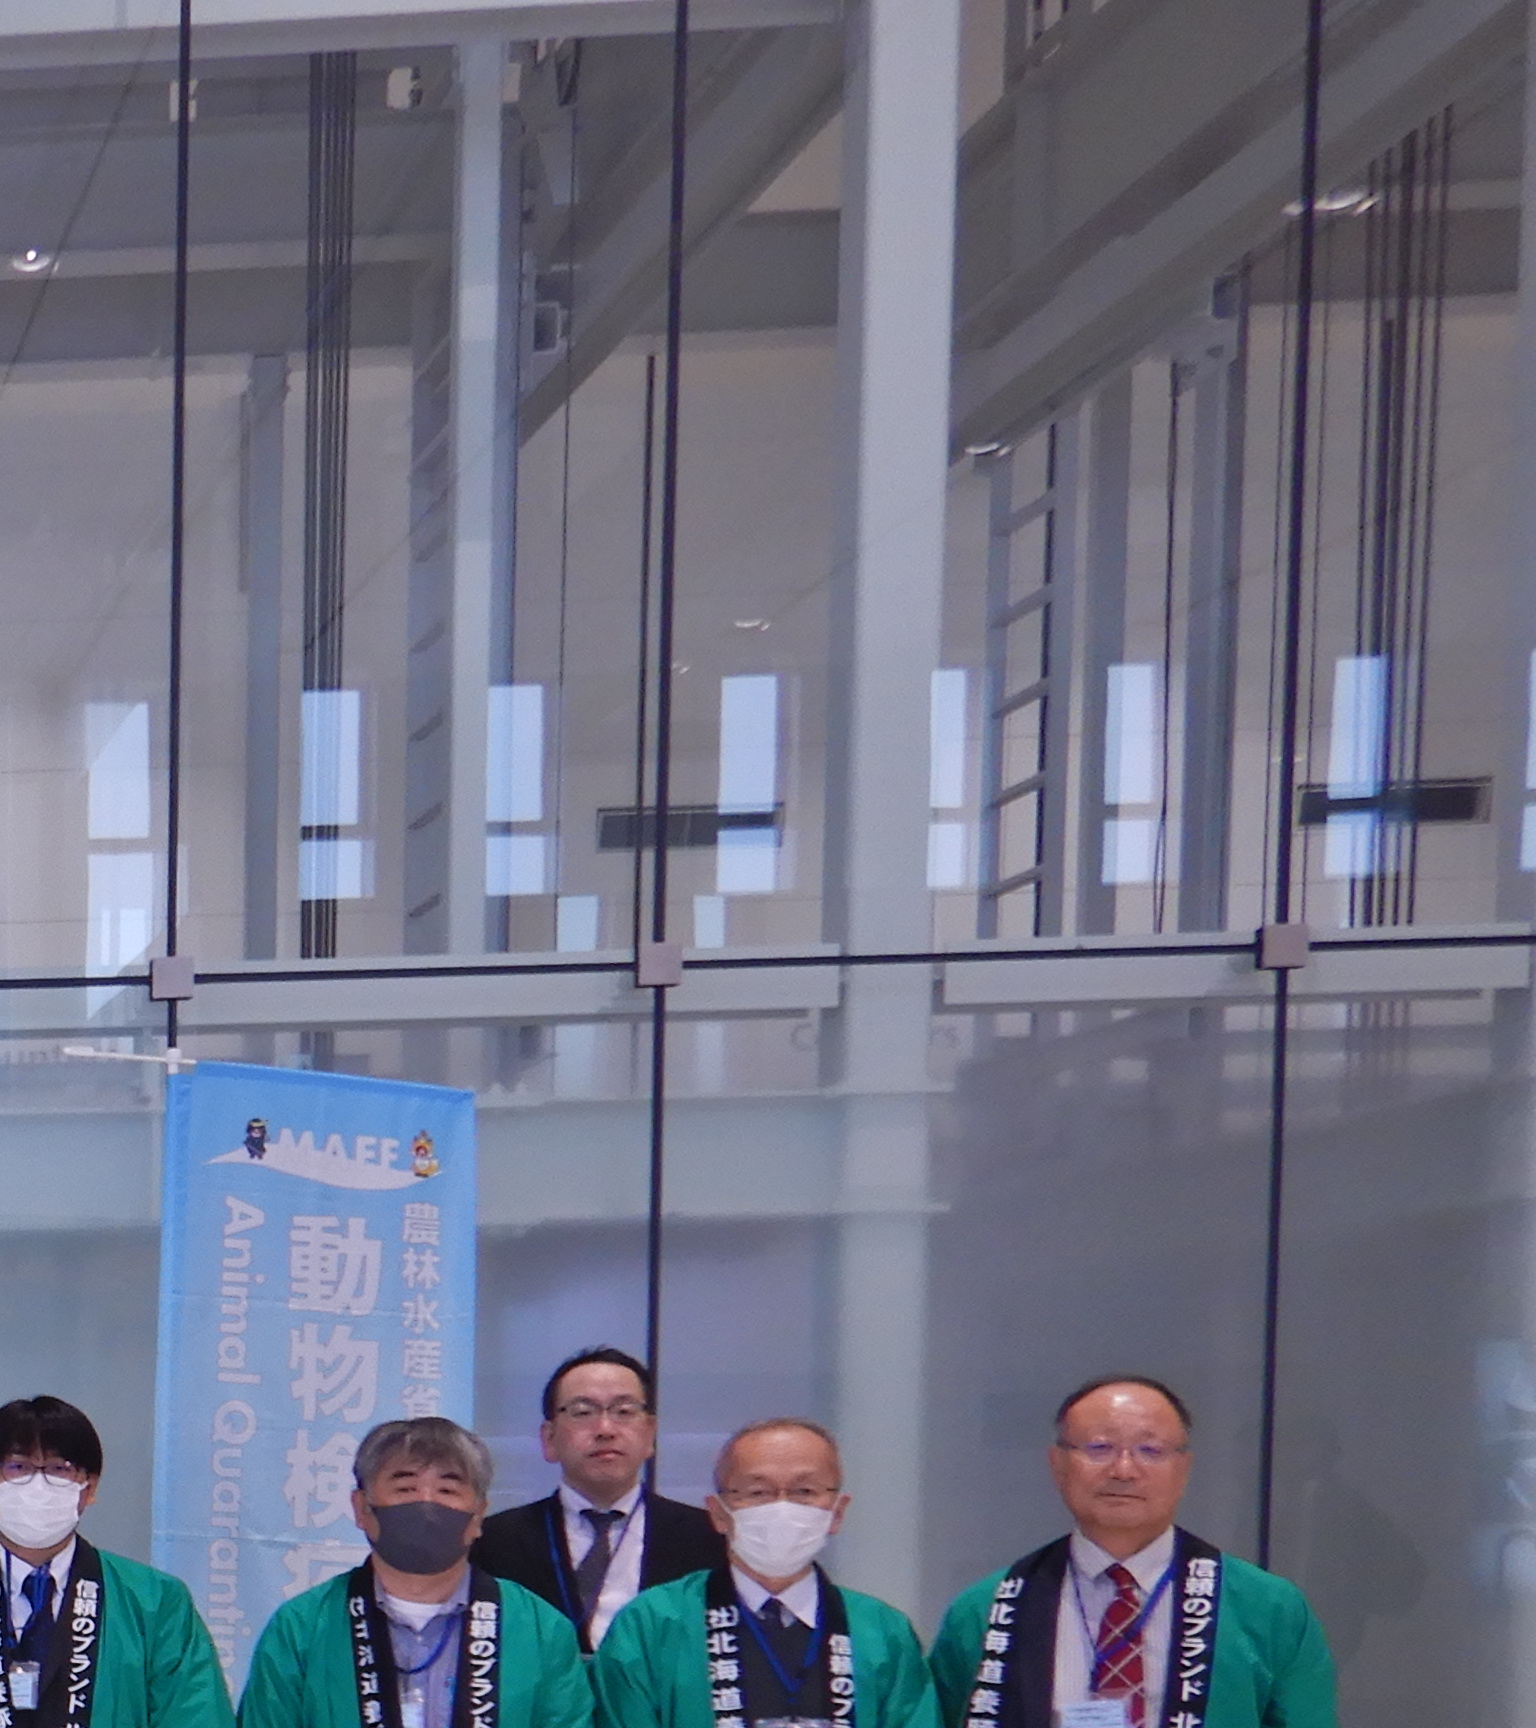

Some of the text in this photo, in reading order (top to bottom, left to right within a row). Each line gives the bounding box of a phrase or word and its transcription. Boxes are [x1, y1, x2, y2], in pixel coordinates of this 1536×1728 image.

[278, 1127, 400, 1169] MAFF
[216, 1195, 266, 1385] Animal
[67, 1578, 100, 1715] 信頼のブランド
[1179, 1557, 1217, 1701] 信頼のブランド
